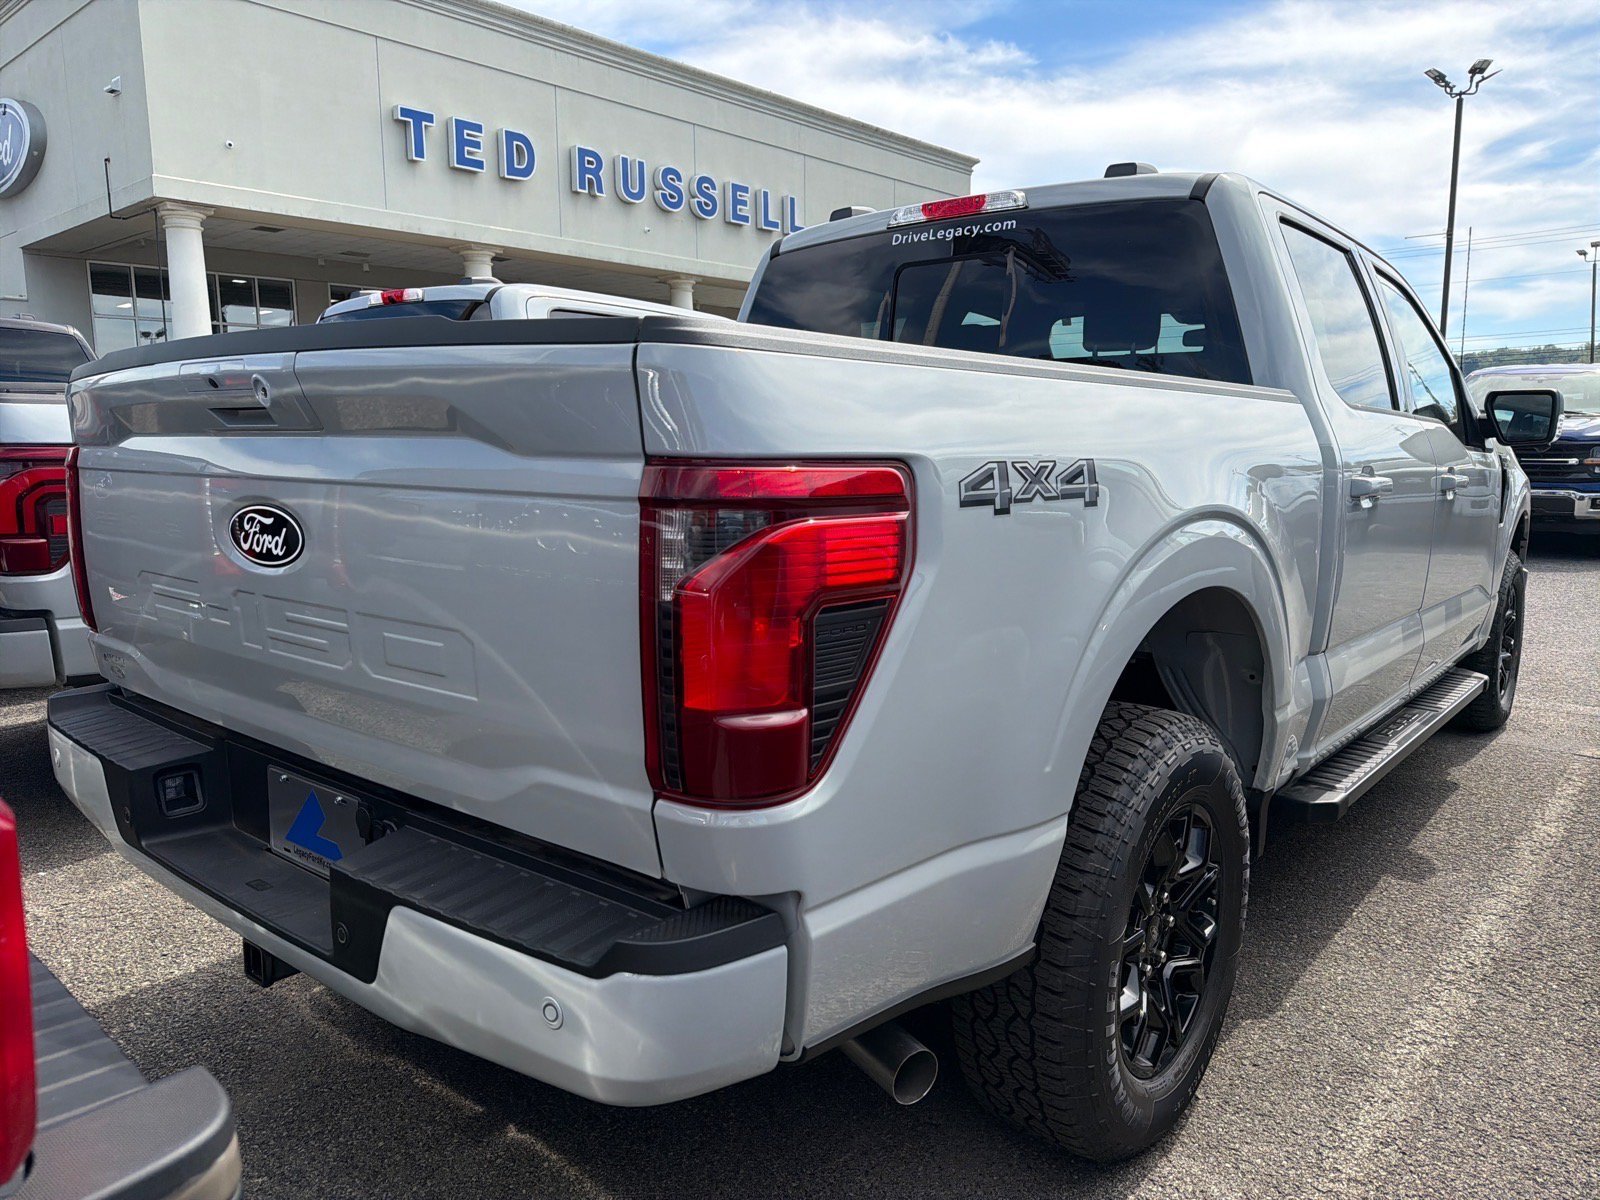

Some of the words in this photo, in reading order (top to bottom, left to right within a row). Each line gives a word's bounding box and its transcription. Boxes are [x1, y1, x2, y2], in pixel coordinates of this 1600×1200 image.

[393, 104, 537, 180] TED
[571, 144, 805, 234] RUSSELL
[891, 219, 1017, 246] DriveLegacy.com
[240, 512, 287, 557] Ford
